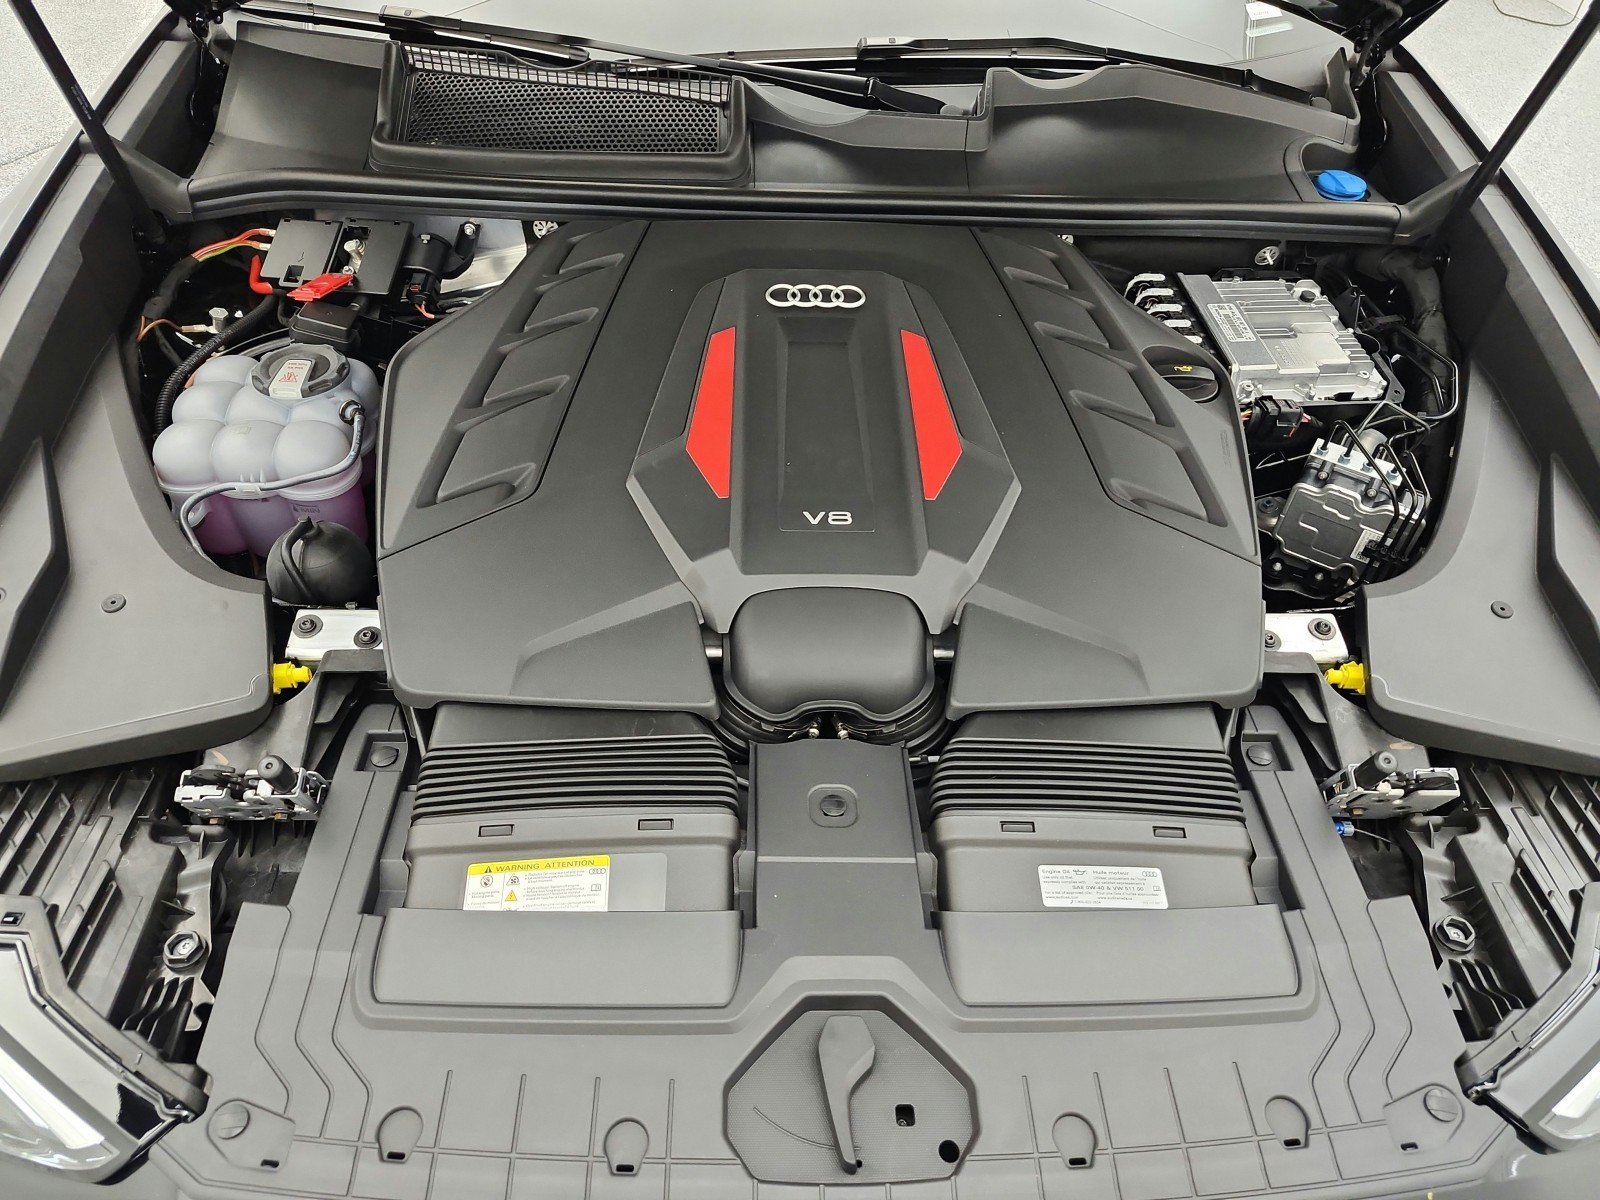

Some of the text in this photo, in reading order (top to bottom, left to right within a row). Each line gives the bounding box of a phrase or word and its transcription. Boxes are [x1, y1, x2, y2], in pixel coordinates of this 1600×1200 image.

[802, 511, 853, 525] V8
[496, 860, 595, 872] WARNING ATTENTION
